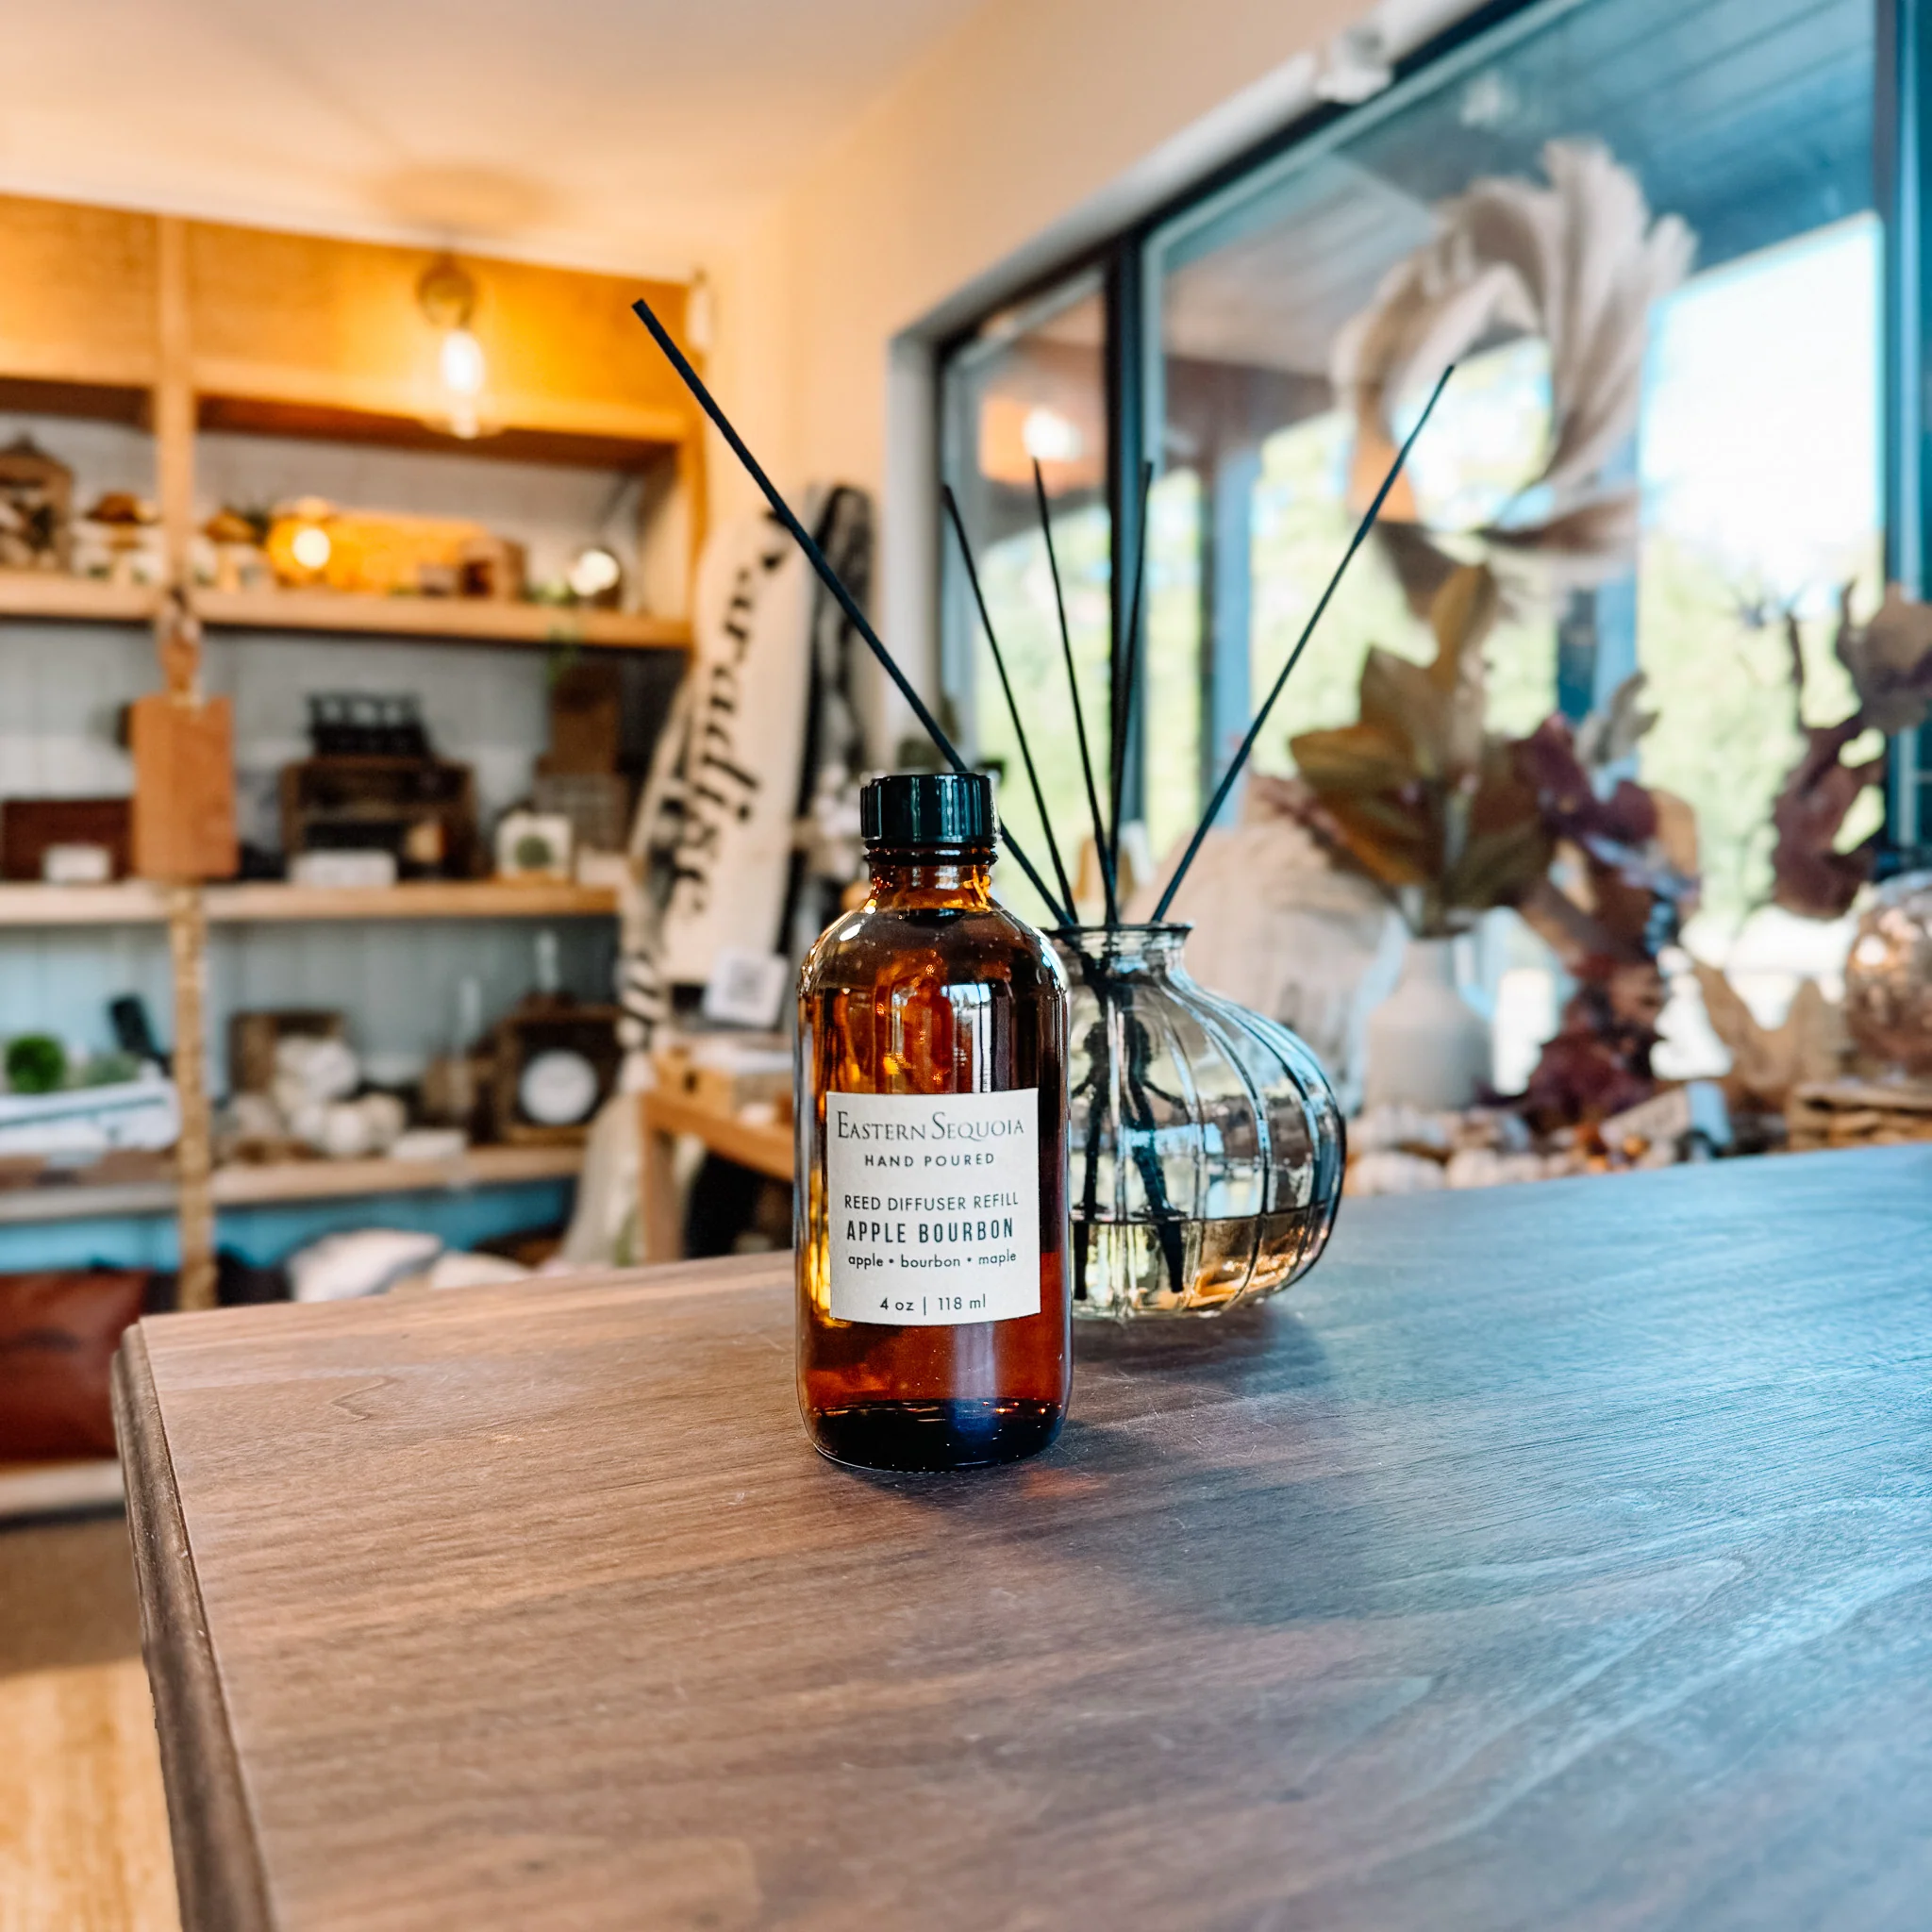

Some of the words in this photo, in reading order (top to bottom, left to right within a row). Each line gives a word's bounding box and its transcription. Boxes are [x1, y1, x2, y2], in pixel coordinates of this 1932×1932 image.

[837, 1110, 925, 1141] EASTERN
[931, 1111, 1024, 1141] SEQUOIA
[864, 1154, 914, 1168] HAND
[924, 1153, 994, 1168] POURED
[844, 1194, 881, 1210] REED
[888, 1196, 967, 1212] DIFFUSER
[974, 1191, 1019, 1209] REFILL
[846, 1220, 906, 1243] APPLE
[919, 1217, 1013, 1243] BOURBON
[848, 1252, 884, 1270] apple
[901, 1254, 960, 1269] bourbon
[978, 1248, 1017, 1267] maple
[879, 1297, 889, 1311] 4
[895, 1301, 915, 1312] oz
[938, 1296, 963, 1311] 118
[969, 1292, 987, 1309] ml
